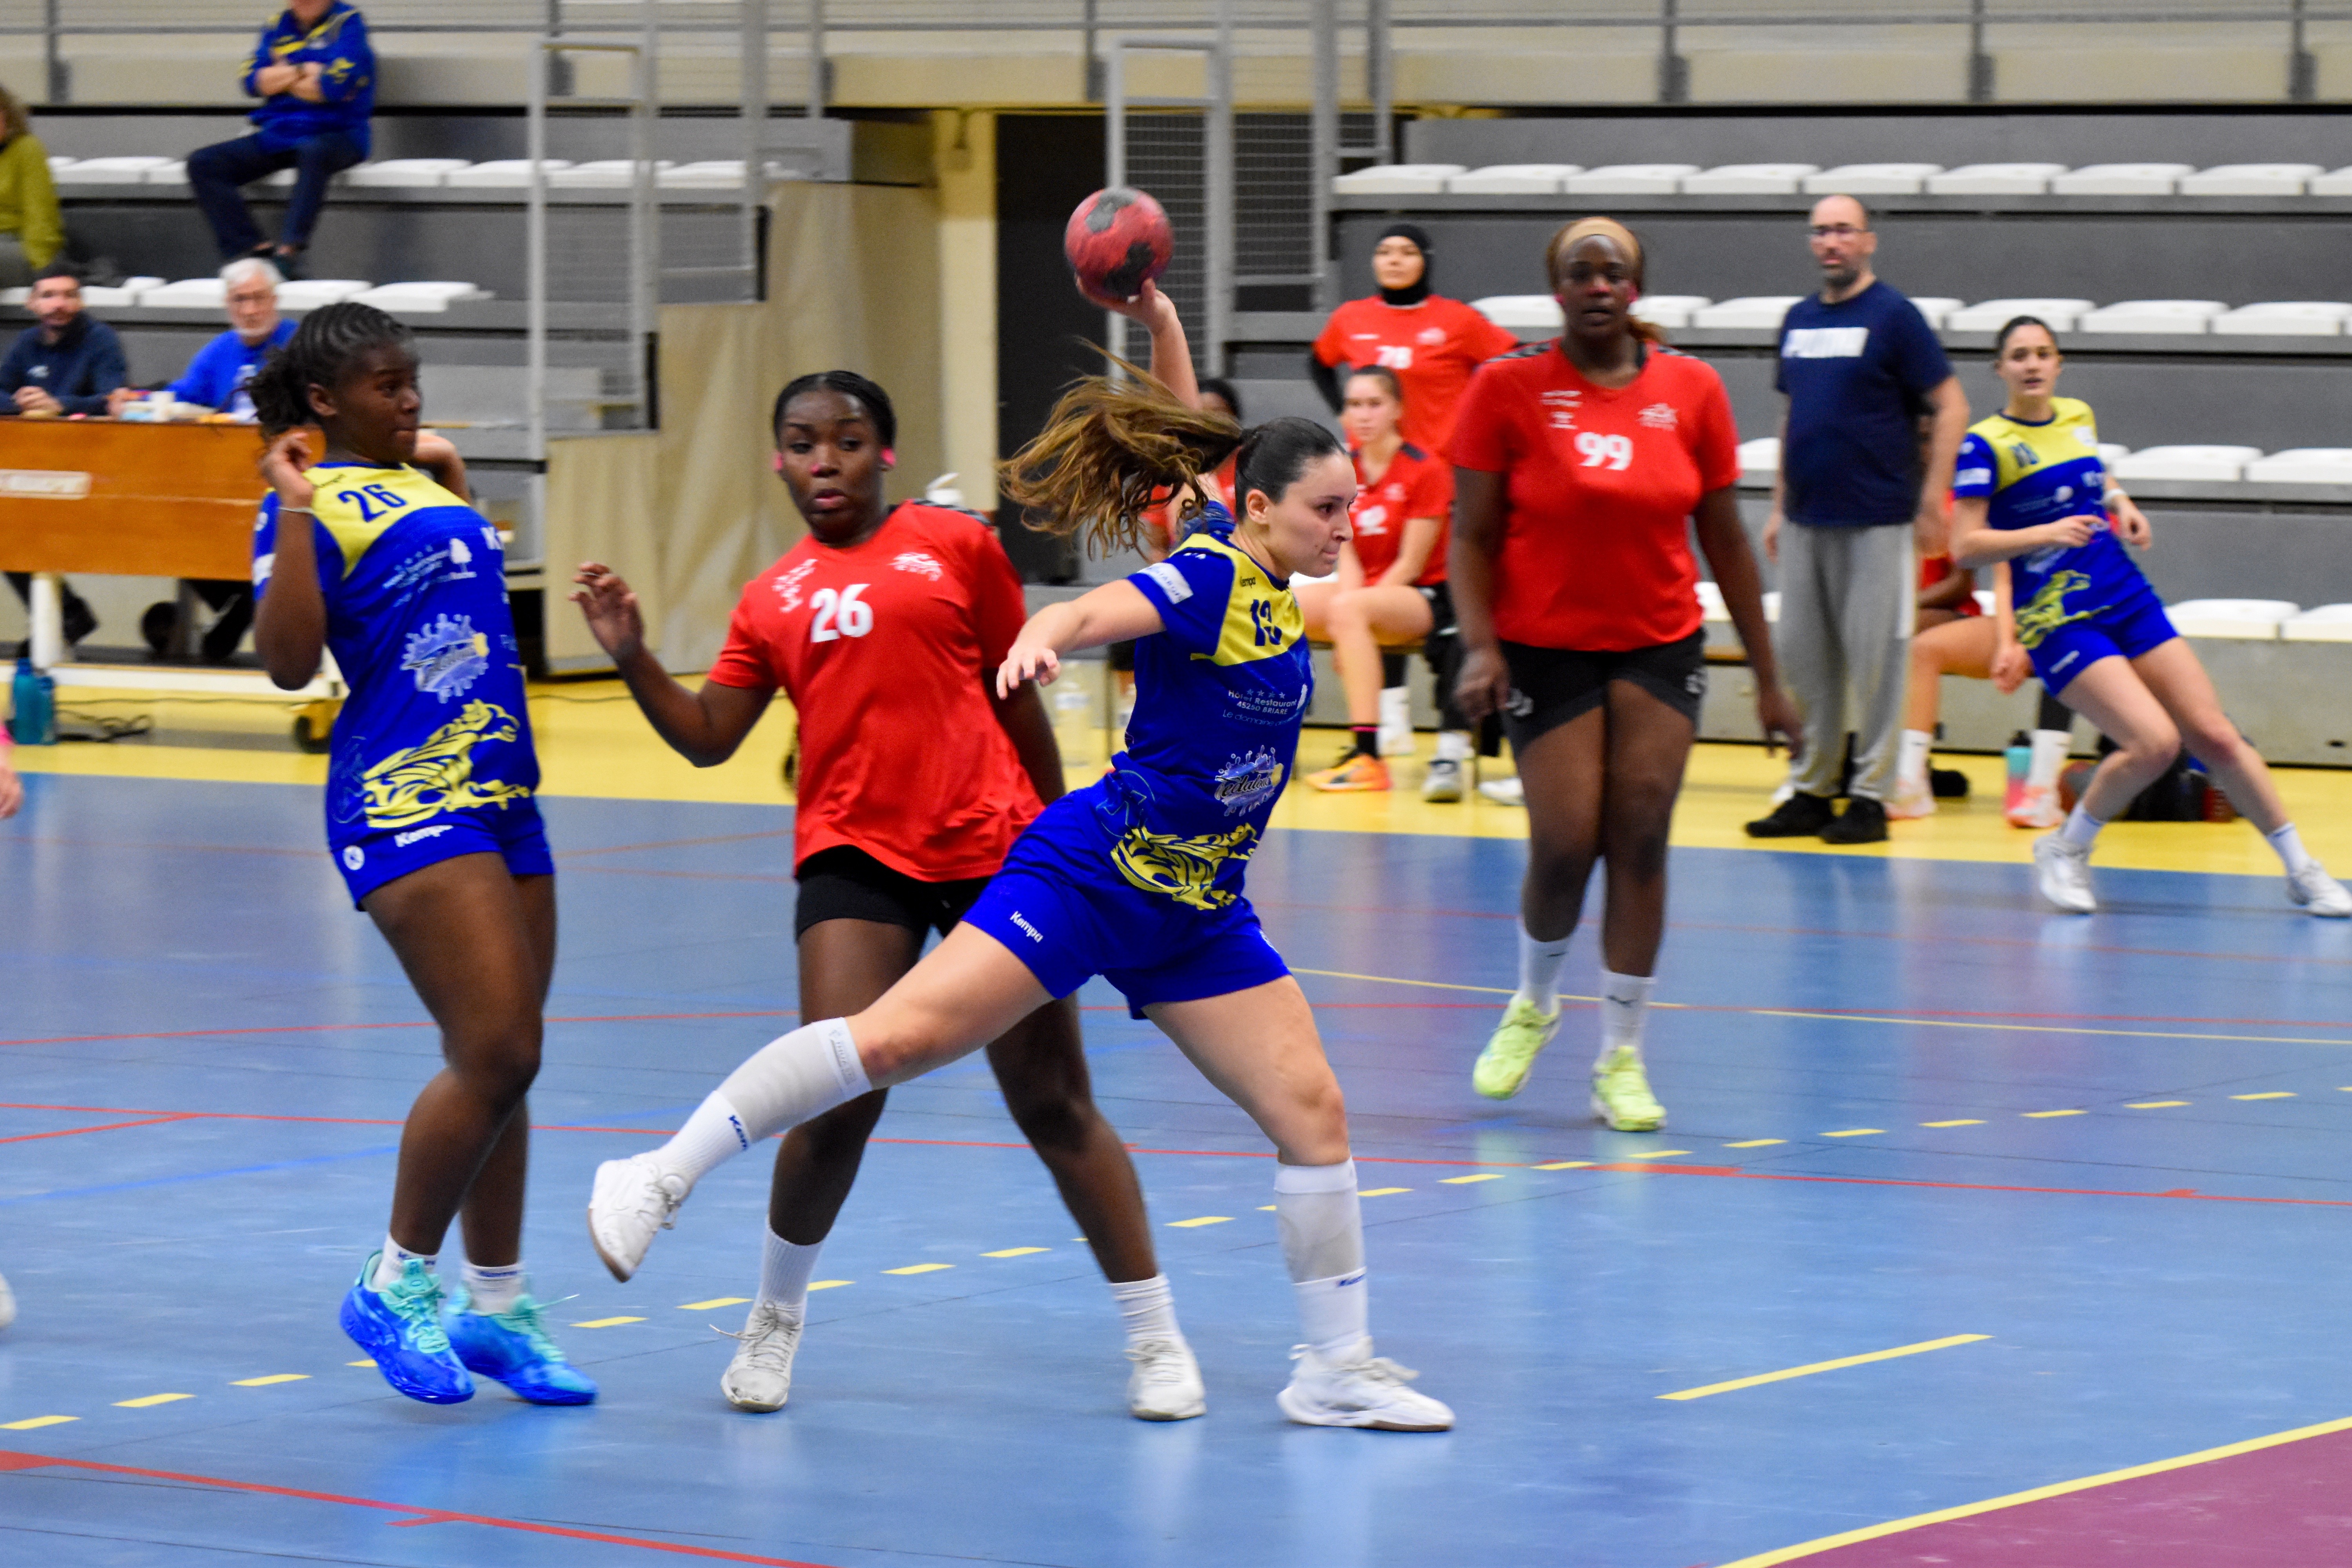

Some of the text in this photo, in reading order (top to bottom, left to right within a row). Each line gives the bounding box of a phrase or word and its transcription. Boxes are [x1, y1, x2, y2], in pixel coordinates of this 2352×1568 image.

[1575, 432, 1633, 471] 99
[338, 484, 408, 523] 26
[809, 584, 874, 643] 26
[1223, 709, 1233, 718] Le
[1254, 697, 1297, 707] Restaurant
[1262, 707, 1289, 715] BRIARE
[1010, 911, 1044, 943] Kempa
